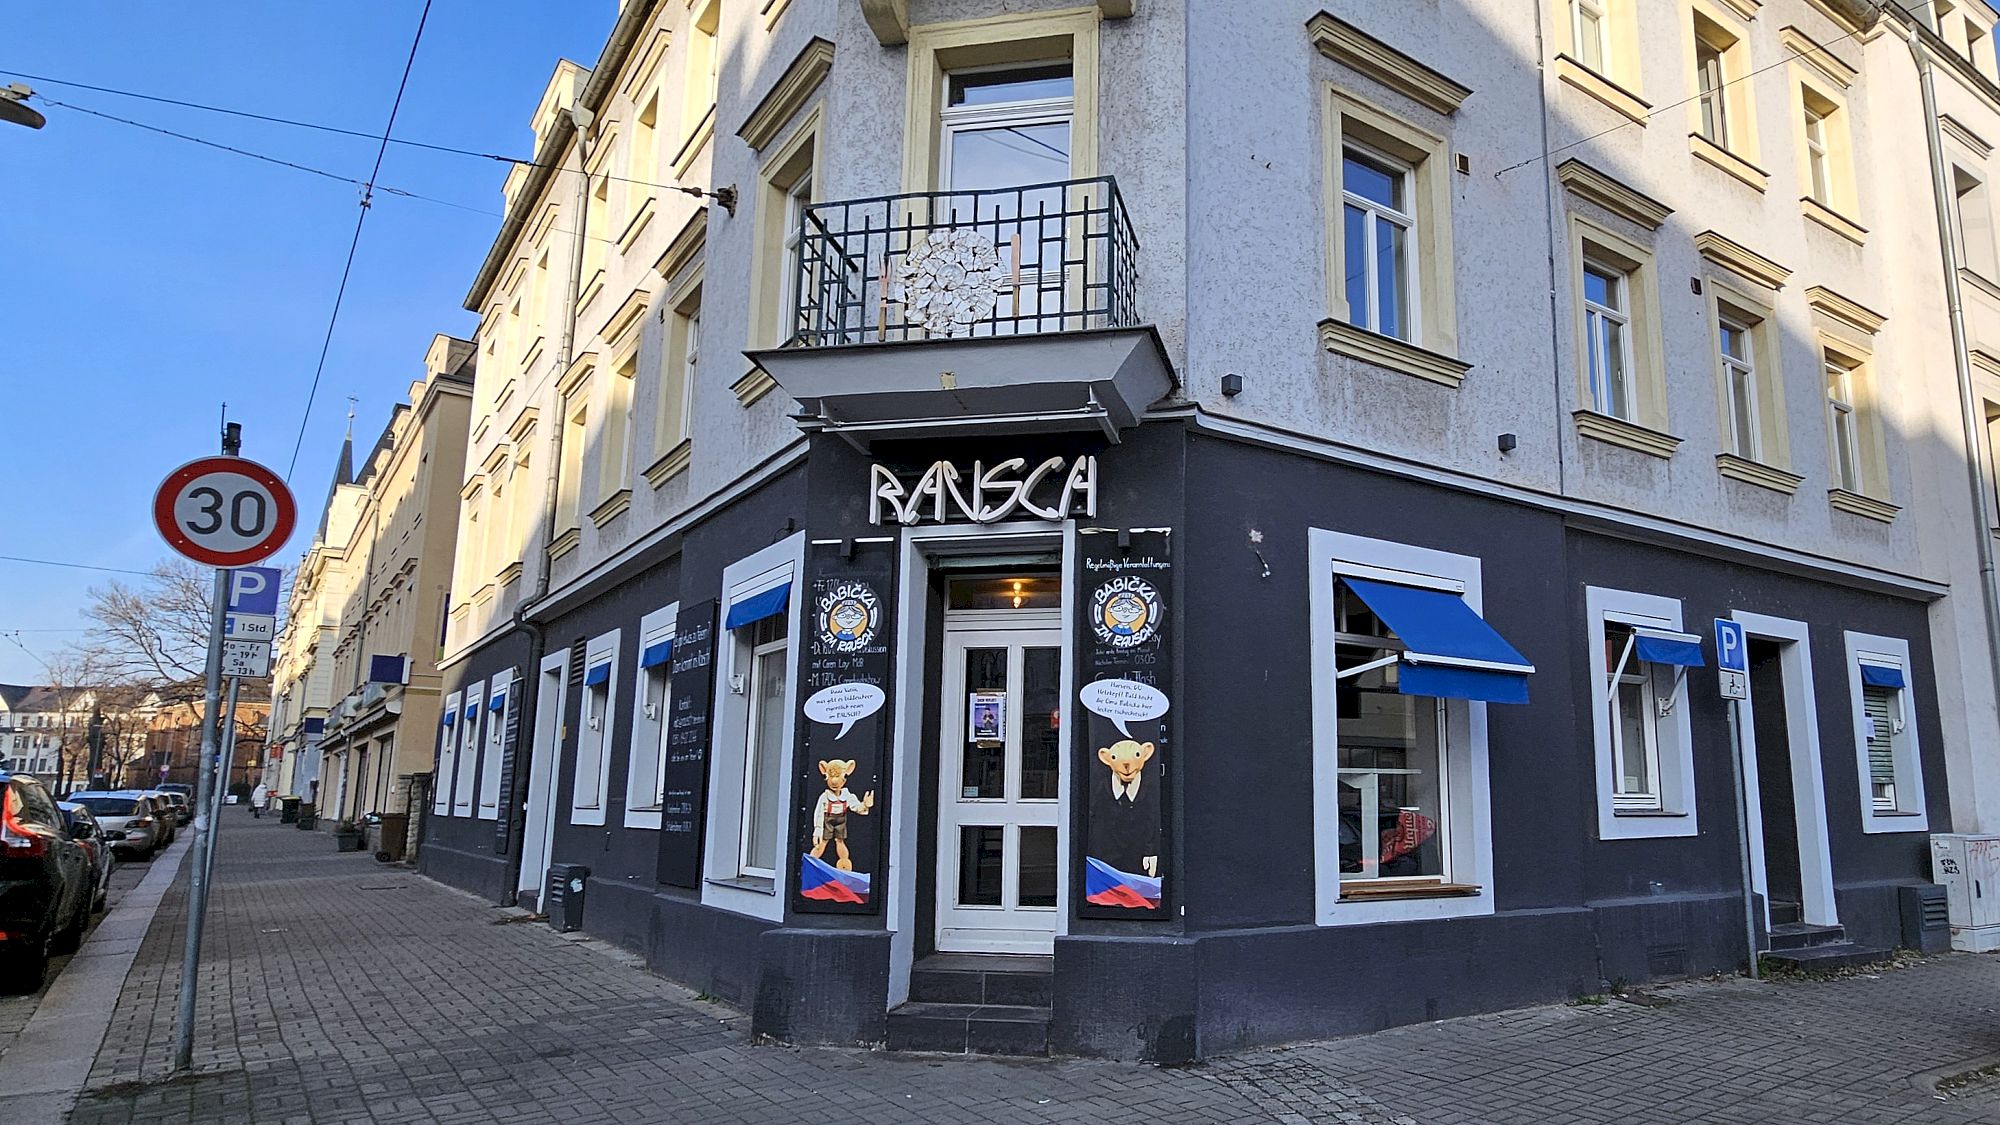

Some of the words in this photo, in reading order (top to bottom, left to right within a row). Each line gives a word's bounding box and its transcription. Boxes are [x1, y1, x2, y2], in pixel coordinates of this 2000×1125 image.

[869, 455, 1097, 526] RAUSCH
[186, 486, 266, 538] 30
[229, 570, 266, 607] P
[820, 583, 877, 613] BABIČKA
[1094, 575, 1156, 605] BABIČKA
[241, 623, 246, 631] 1
[247, 623, 269, 633] Std.
[820, 631, 838, 649] IM
[836, 628, 875, 653] RAUSCH
[1094, 624, 1113, 643] IM
[1112, 623, 1154, 648] RAUSCH
[240, 651, 250, 659] 19
[249, 643, 261, 652] Fr
[1721, 625, 1737, 664] P
[232, 658, 245, 667] Sa
[238, 667, 248, 675] 13
[249, 667, 255, 676] h
